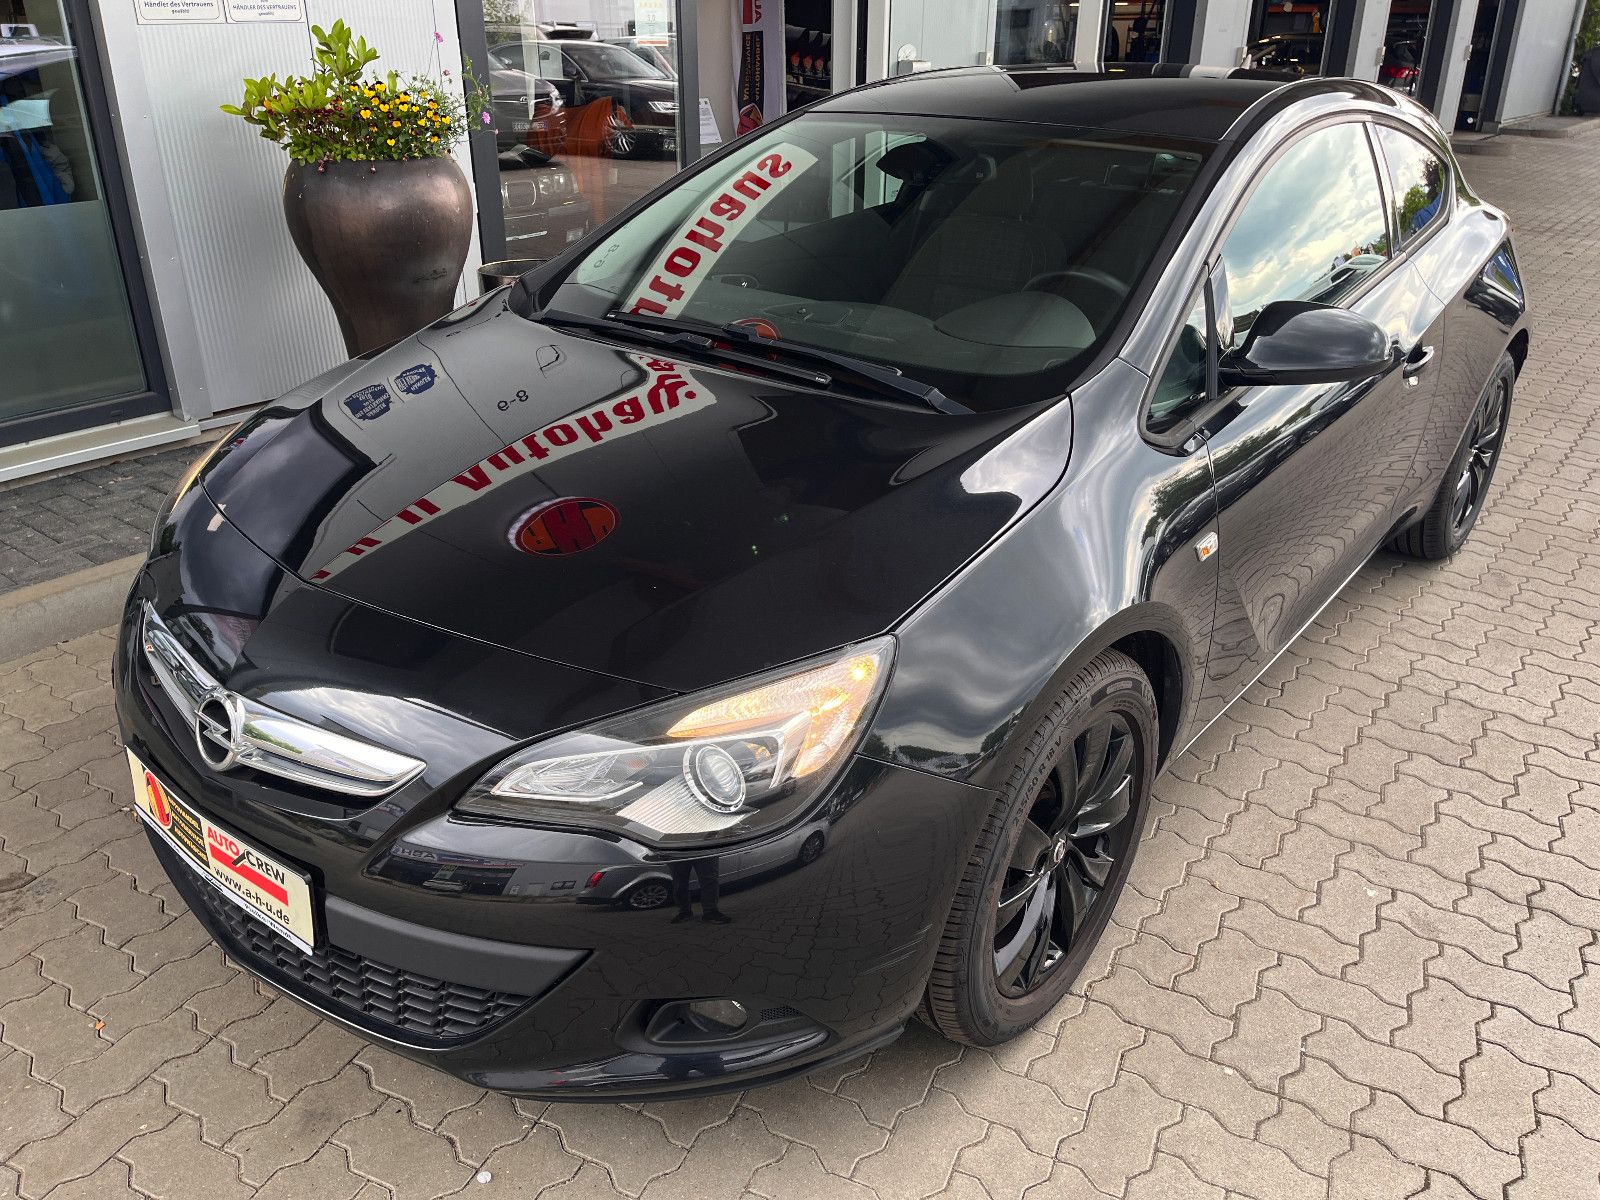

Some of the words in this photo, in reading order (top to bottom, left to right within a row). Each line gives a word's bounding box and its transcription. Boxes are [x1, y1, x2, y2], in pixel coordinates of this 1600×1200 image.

[207, 826, 240, 856] AUTO
[246, 850, 286, 885] CREW
[213, 866, 290, 924] www.a-h-u.de
